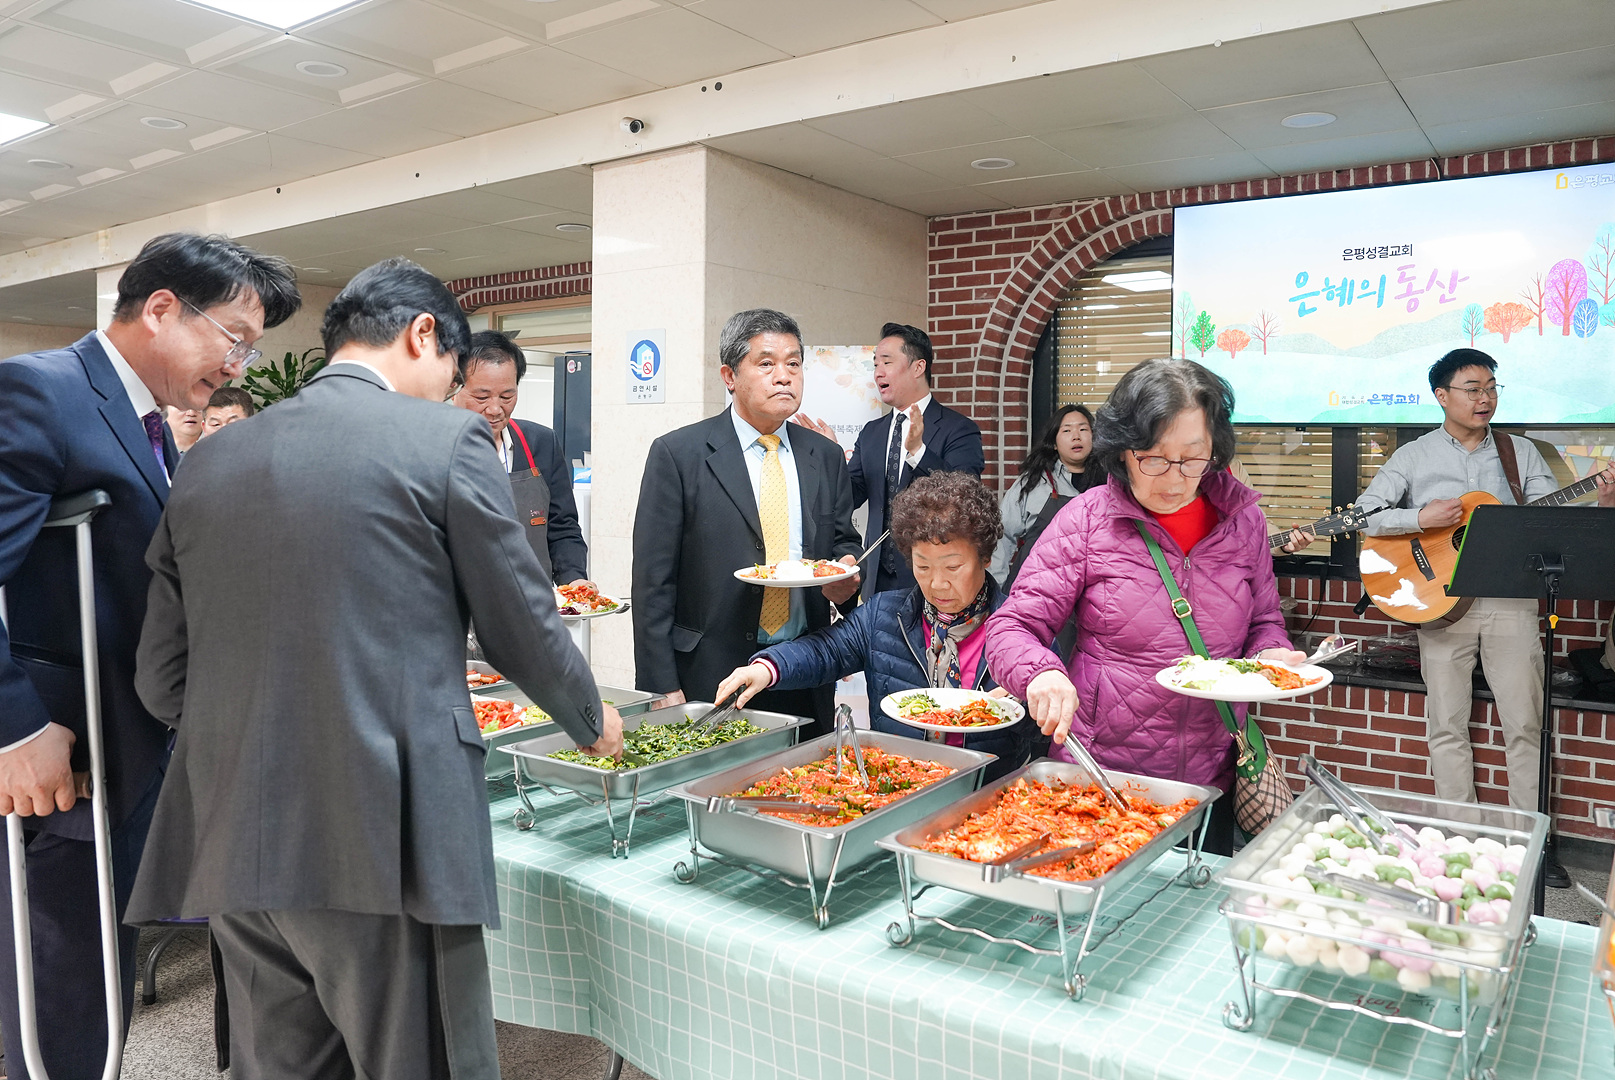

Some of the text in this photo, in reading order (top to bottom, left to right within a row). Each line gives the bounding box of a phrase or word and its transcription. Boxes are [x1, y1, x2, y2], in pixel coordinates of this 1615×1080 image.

[1569, 173, 1615, 189] 은평교
[1342, 243, 1413, 261] 은평성결교회
[1288, 264, 1470, 318] 은혜의 동산
[632, 385, 658, 393] 금연시설
[1367, 393, 1420, 406] 은평교회
